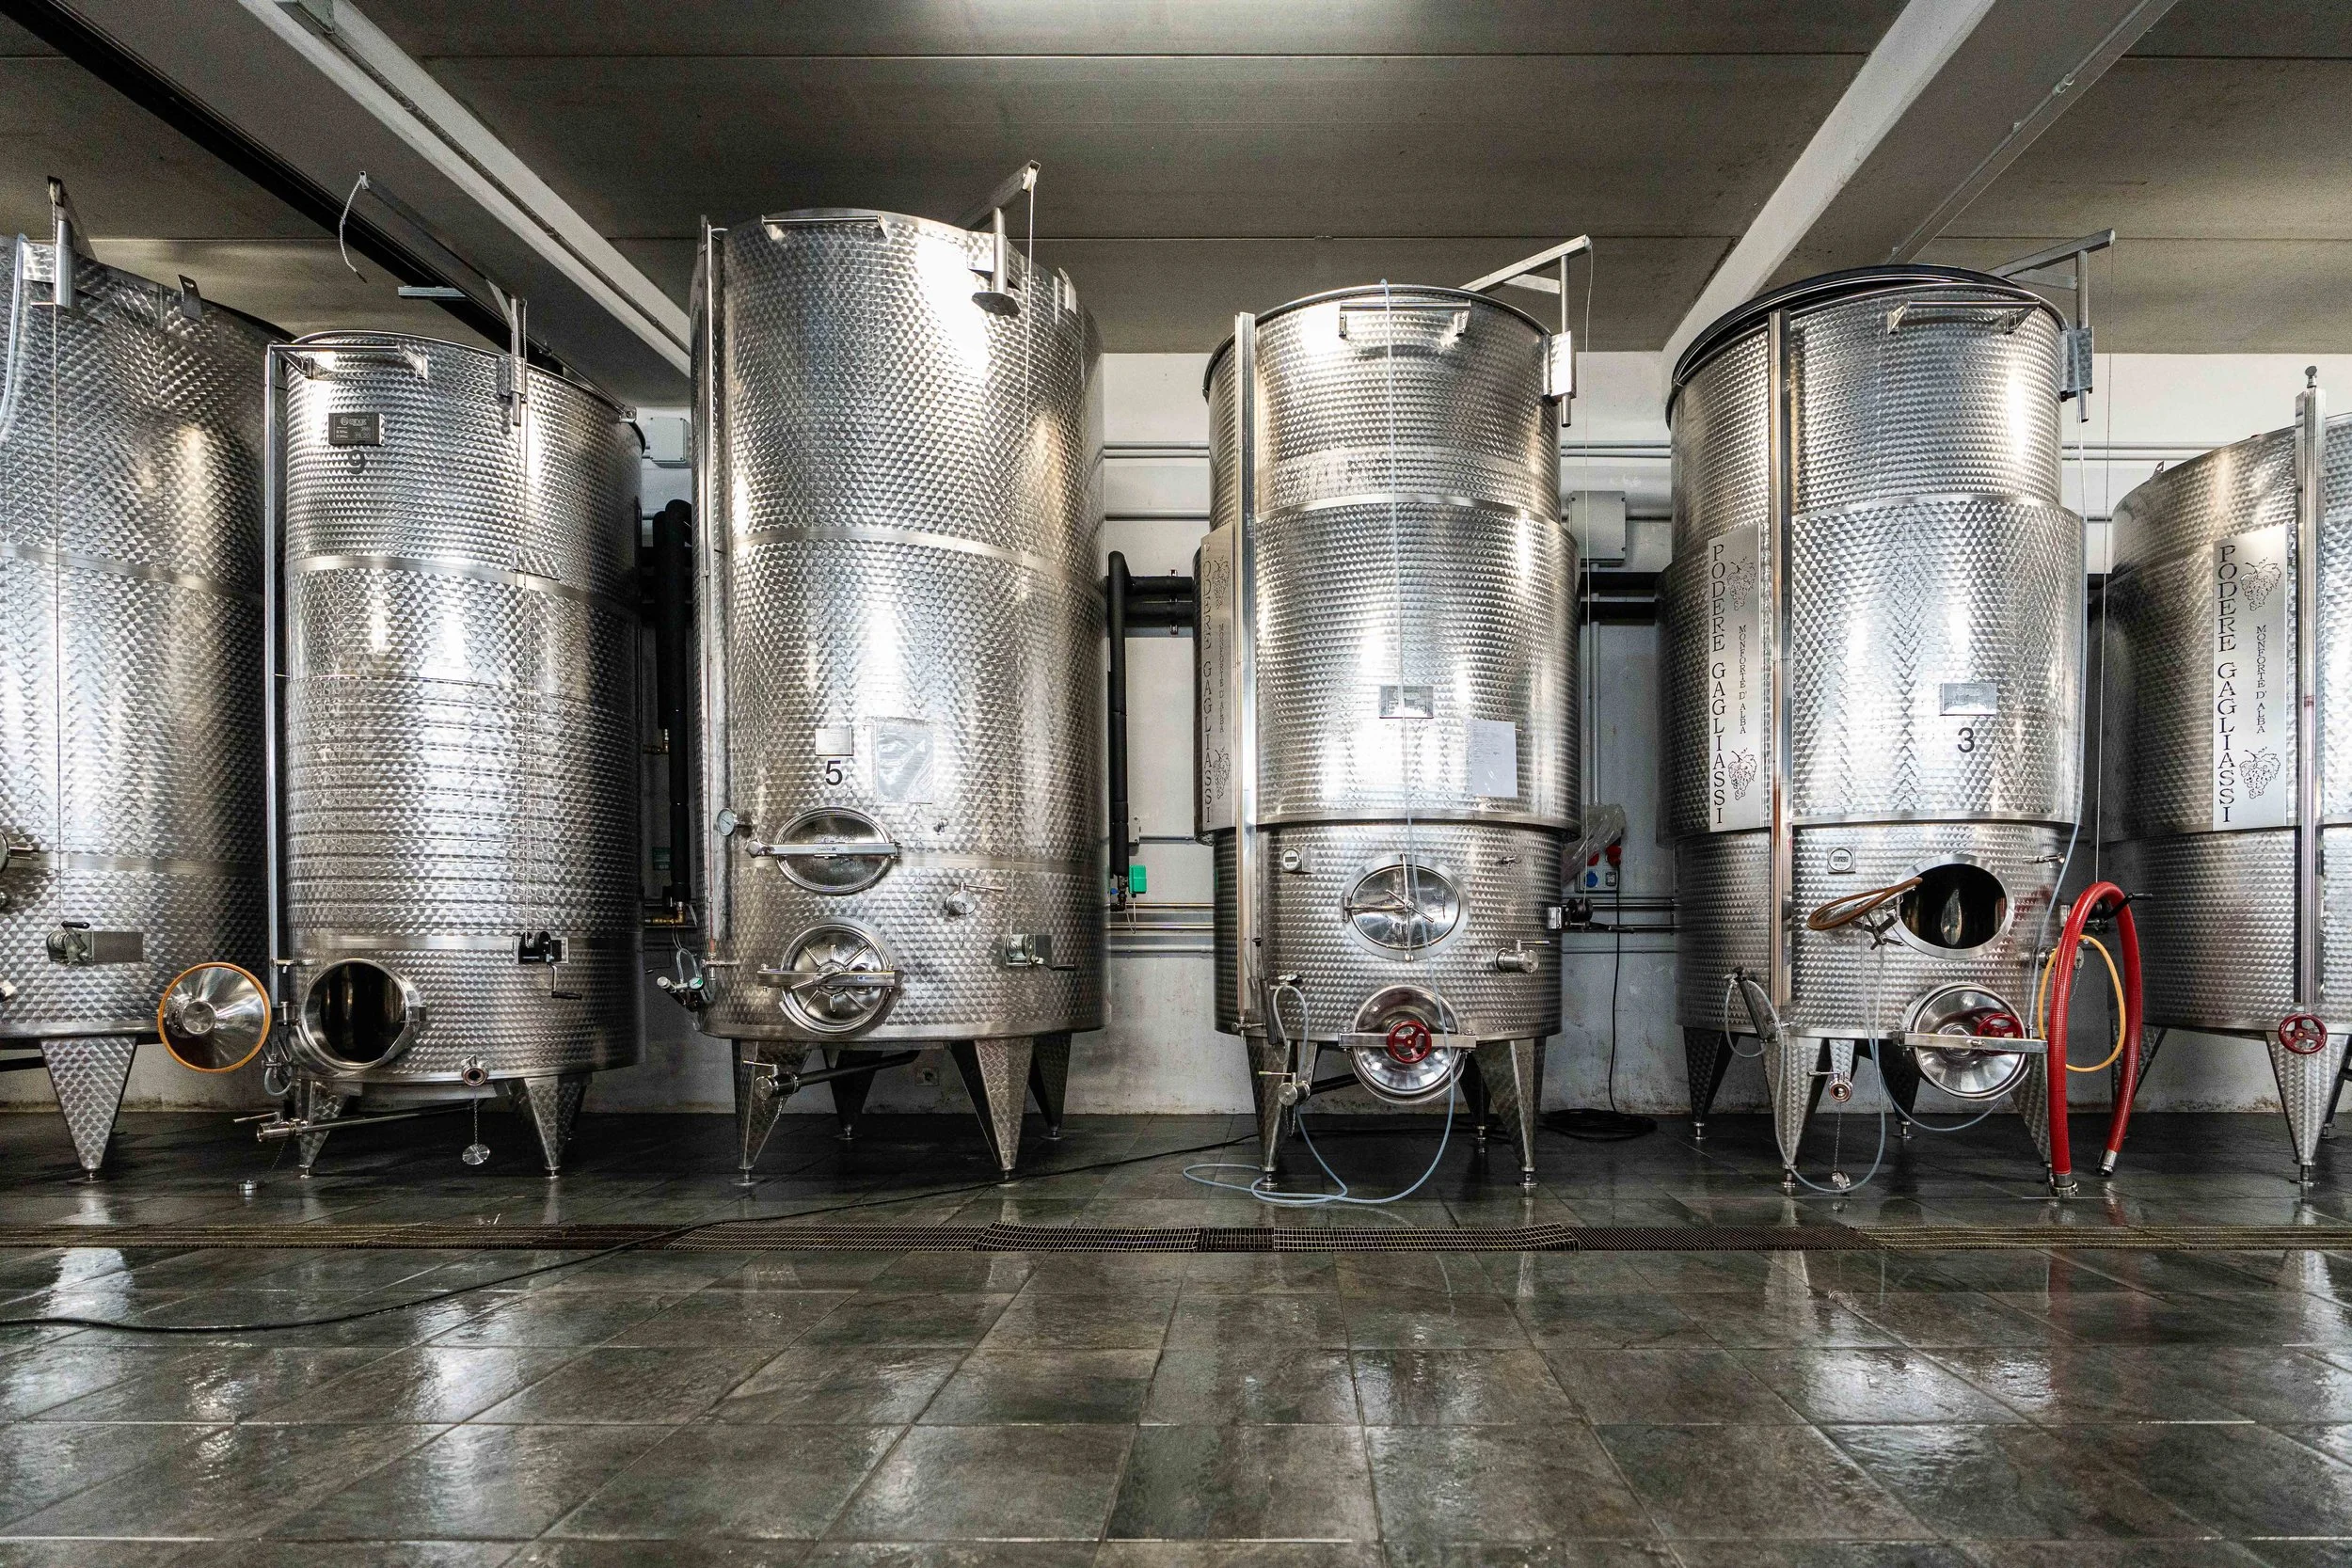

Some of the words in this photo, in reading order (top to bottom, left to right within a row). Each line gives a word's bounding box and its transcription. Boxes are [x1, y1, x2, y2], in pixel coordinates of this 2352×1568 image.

[347, 450, 366, 475] 9
[1711, 544, 1725, 653] PODERE
[2217, 545, 2237, 653] PODERE
[1739, 624, 1747, 689] MONFORTE
[2256, 624, 2266, 689] MONFORTE
[1202, 661, 1213, 823] GAGLIASSI
[1711, 661, 1726, 825] GAGLIASSI
[1957, 726, 1975, 753] 3
[2217, 661, 2238, 823] GAGLIASSI
[2256, 702, 2265, 734] ALBA
[825, 759, 843, 786] 5
